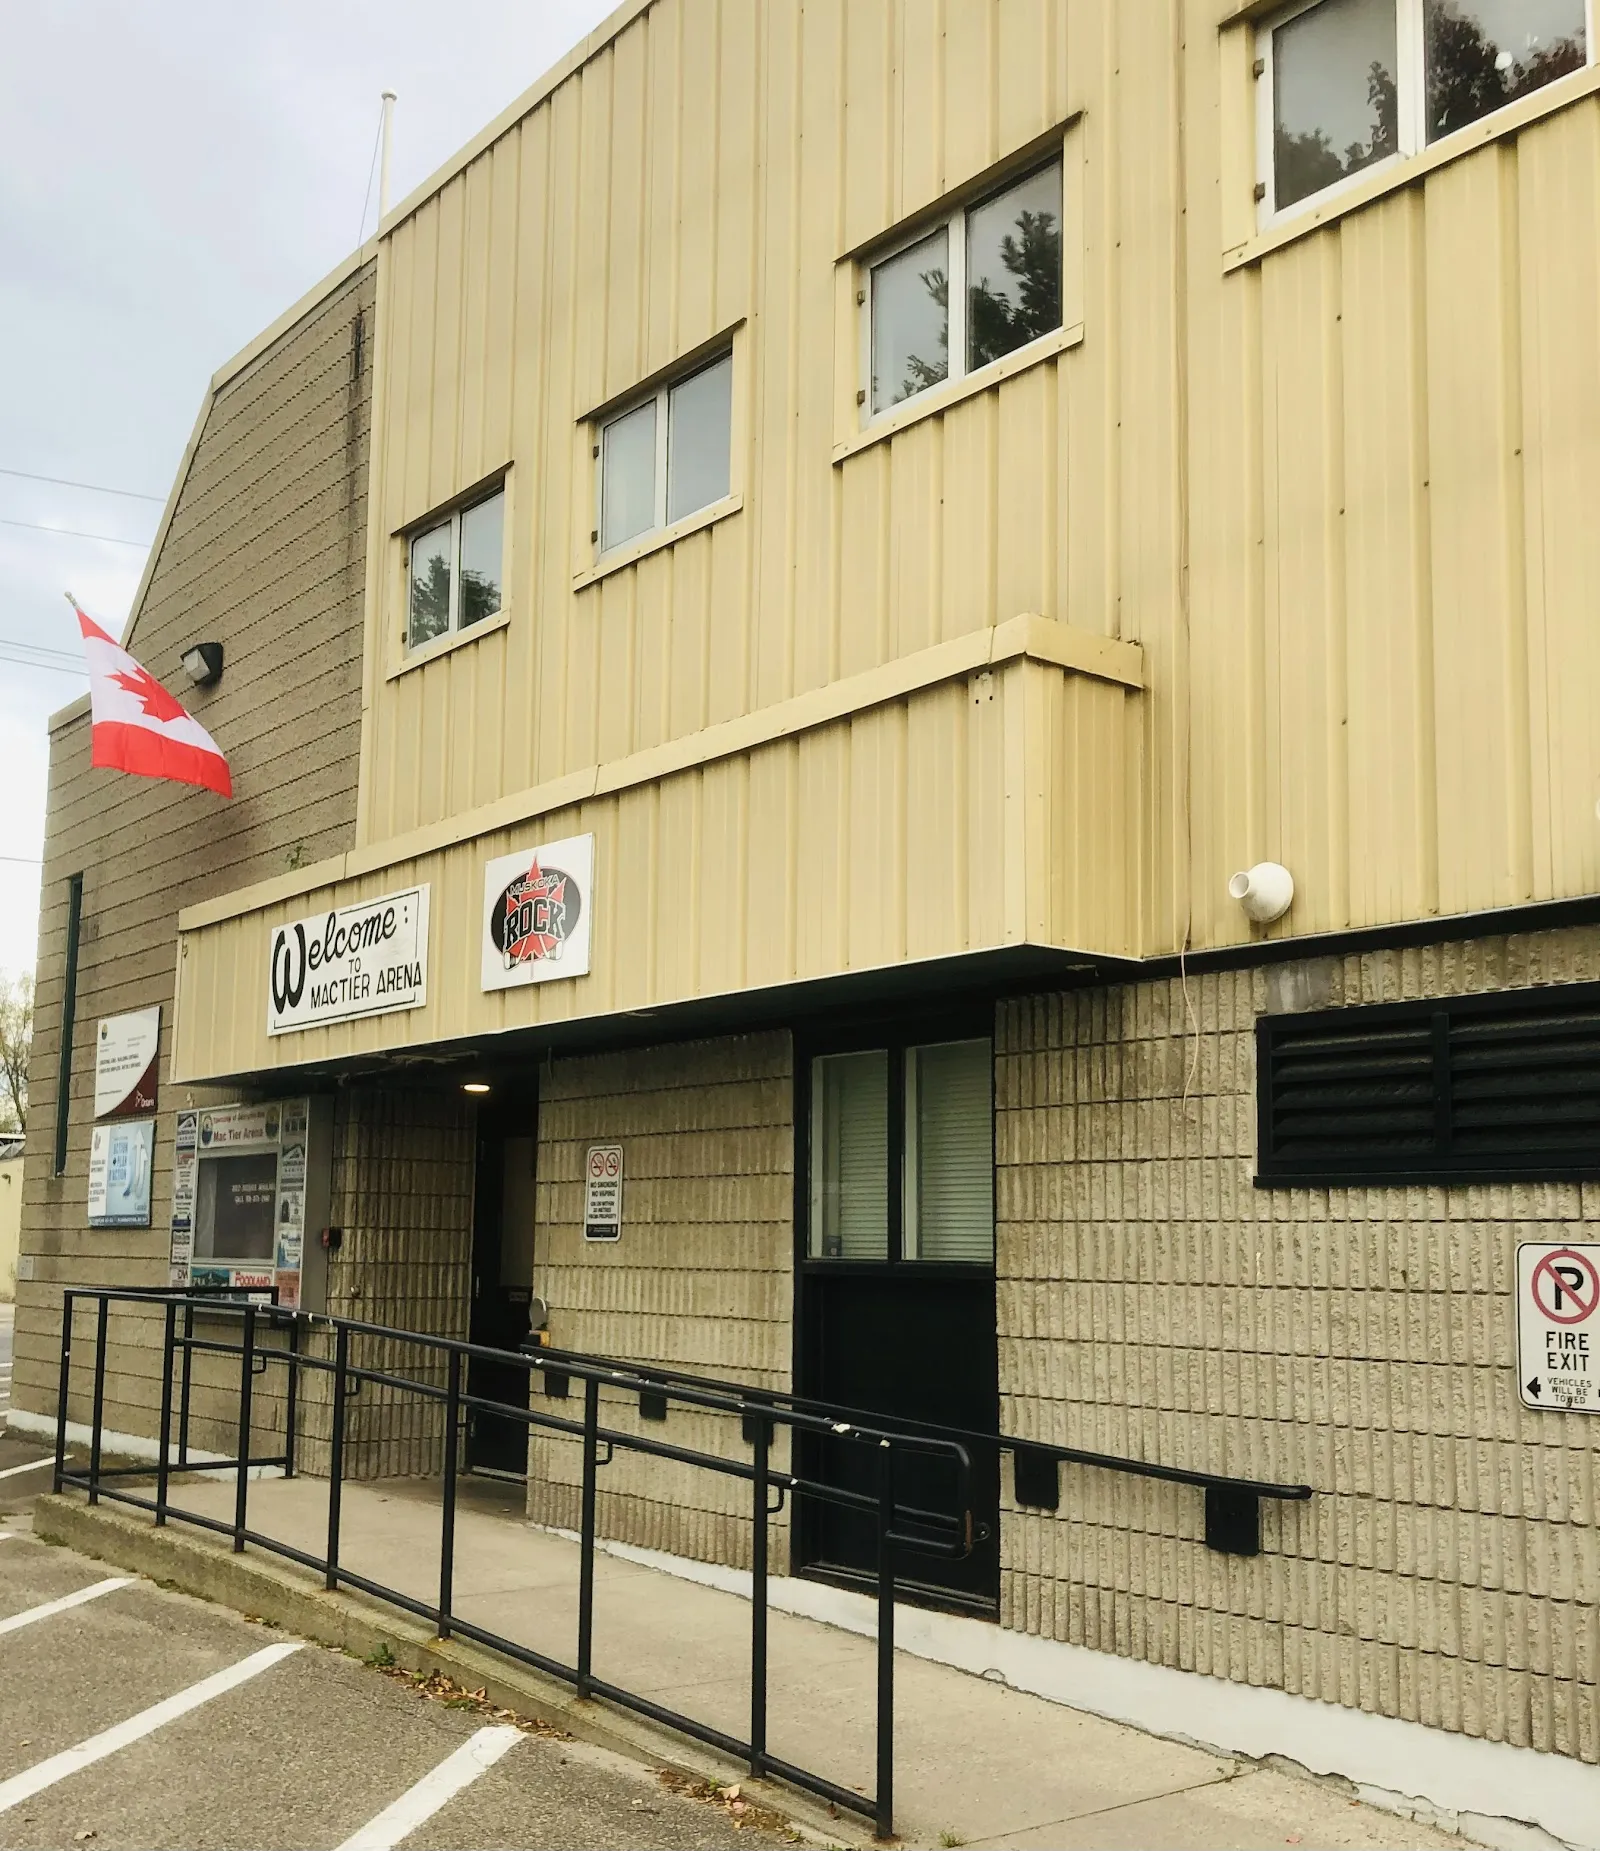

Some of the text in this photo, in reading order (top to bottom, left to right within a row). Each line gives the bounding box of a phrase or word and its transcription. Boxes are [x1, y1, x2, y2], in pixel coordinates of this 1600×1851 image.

[509, 874, 560, 896] MUSKOKA
[503, 896, 566, 952] ROCK
[348, 957, 361, 974] TO
[376, 961, 422, 995] ARENA
[310, 973, 370, 1009] MACTIER
[213, 1127, 264, 1142] Mac Tier Arena
[1545, 1331, 1590, 1351] FIRE
[1547, 1352, 1590, 1372] EXIT
[1547, 1377, 1593, 1388] VEHICLES
[1551, 1386, 1588, 1397] WILL BE
